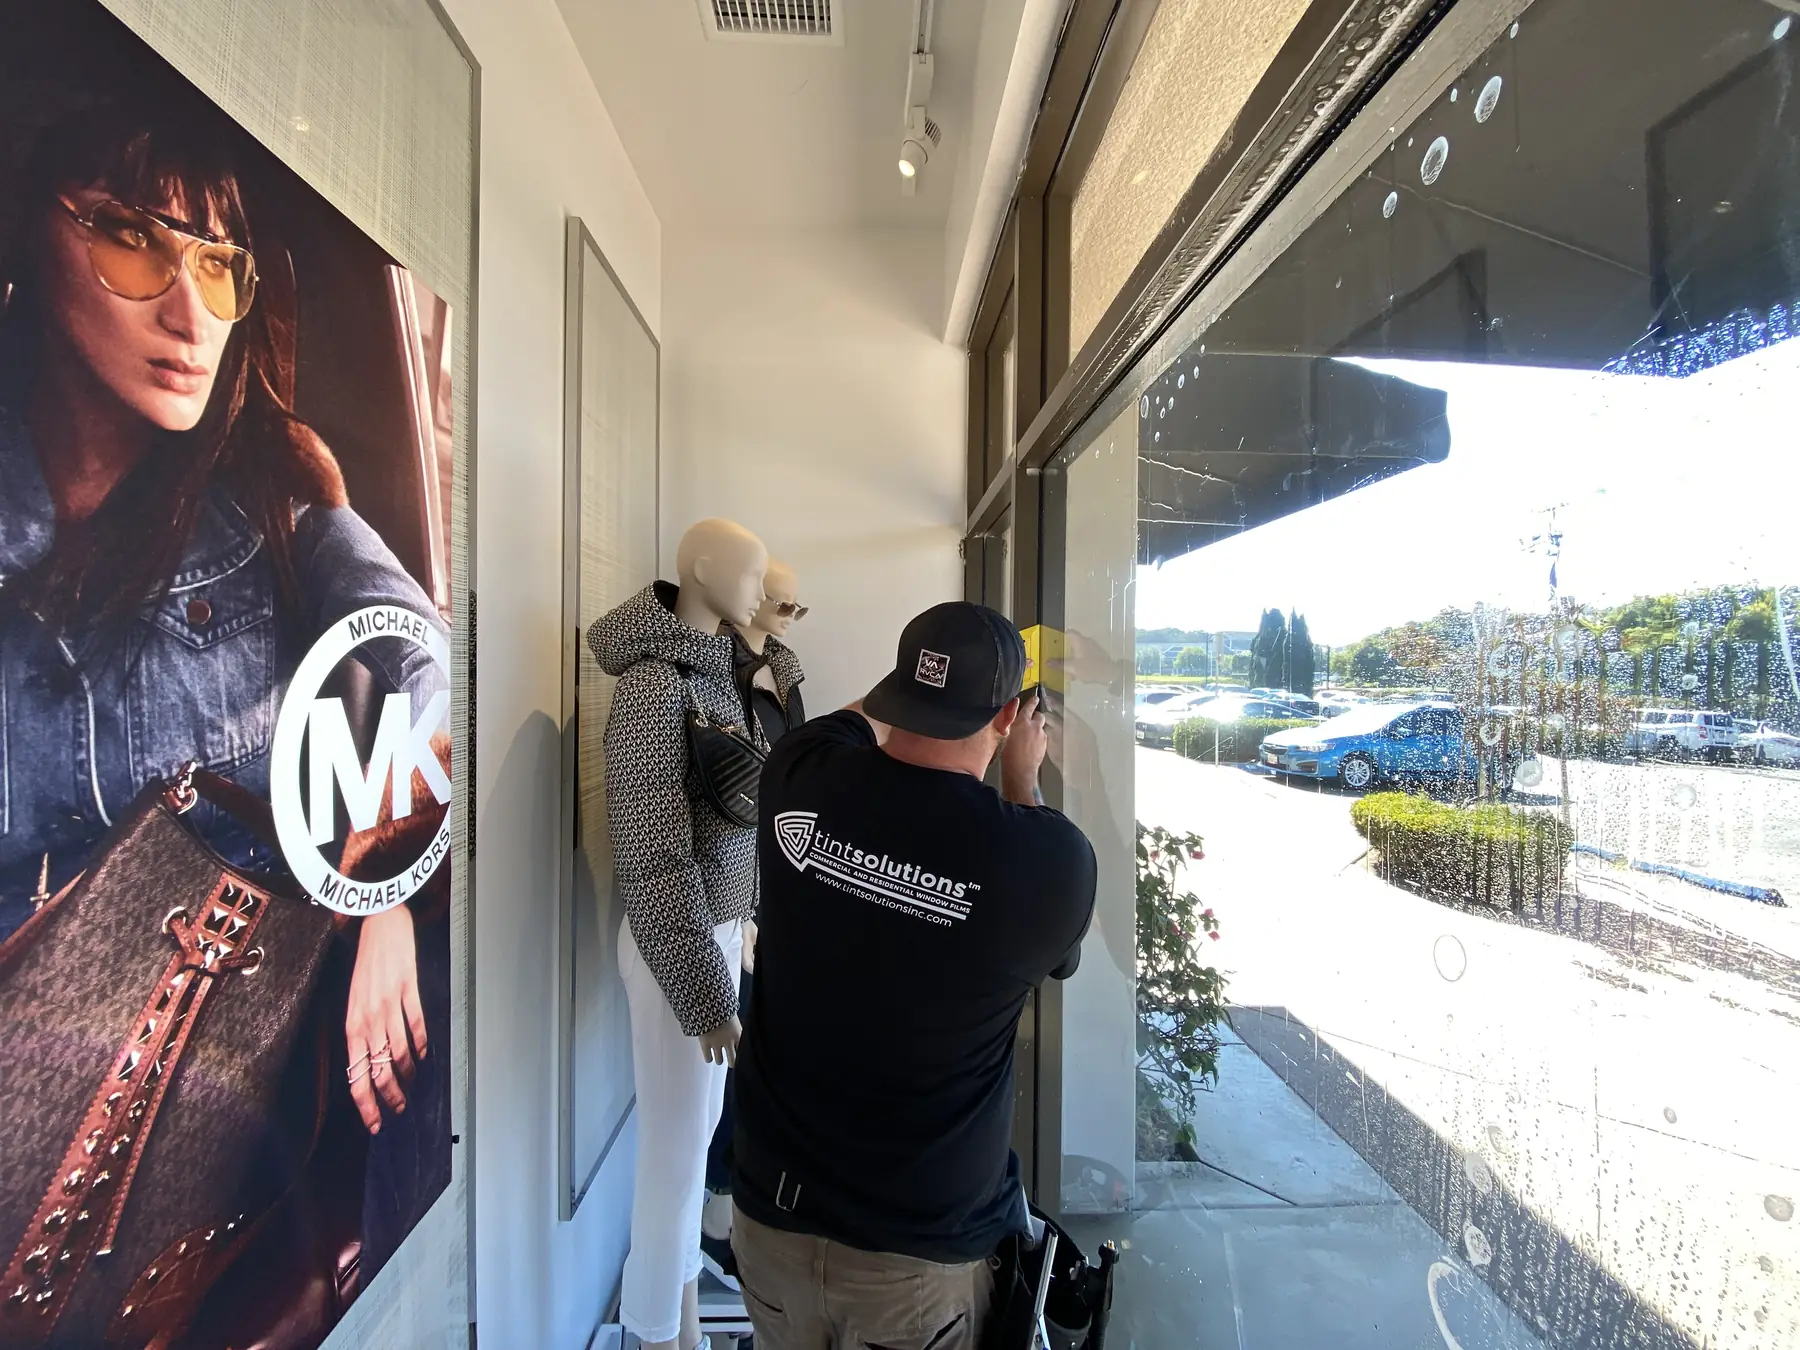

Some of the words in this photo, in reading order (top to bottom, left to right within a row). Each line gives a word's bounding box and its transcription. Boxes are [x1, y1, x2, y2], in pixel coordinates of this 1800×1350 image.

[348, 611, 429, 645] MICHAEL
[310, 689, 451, 847] MK
[318, 872, 407, 910] MICHAEL
[411, 828, 450, 886] KORS
[809, 851, 851, 874] COMMERCIAL
[853, 870, 868, 880] AND
[869, 876, 914, 896] RESIDENTIAL
[916, 891, 949, 907] WINDOW
[949, 903, 971, 914] FILMS
[814, 830, 967, 898] tintsolutions
[815, 872, 952, 927] www.tintsolutionsinc.com
